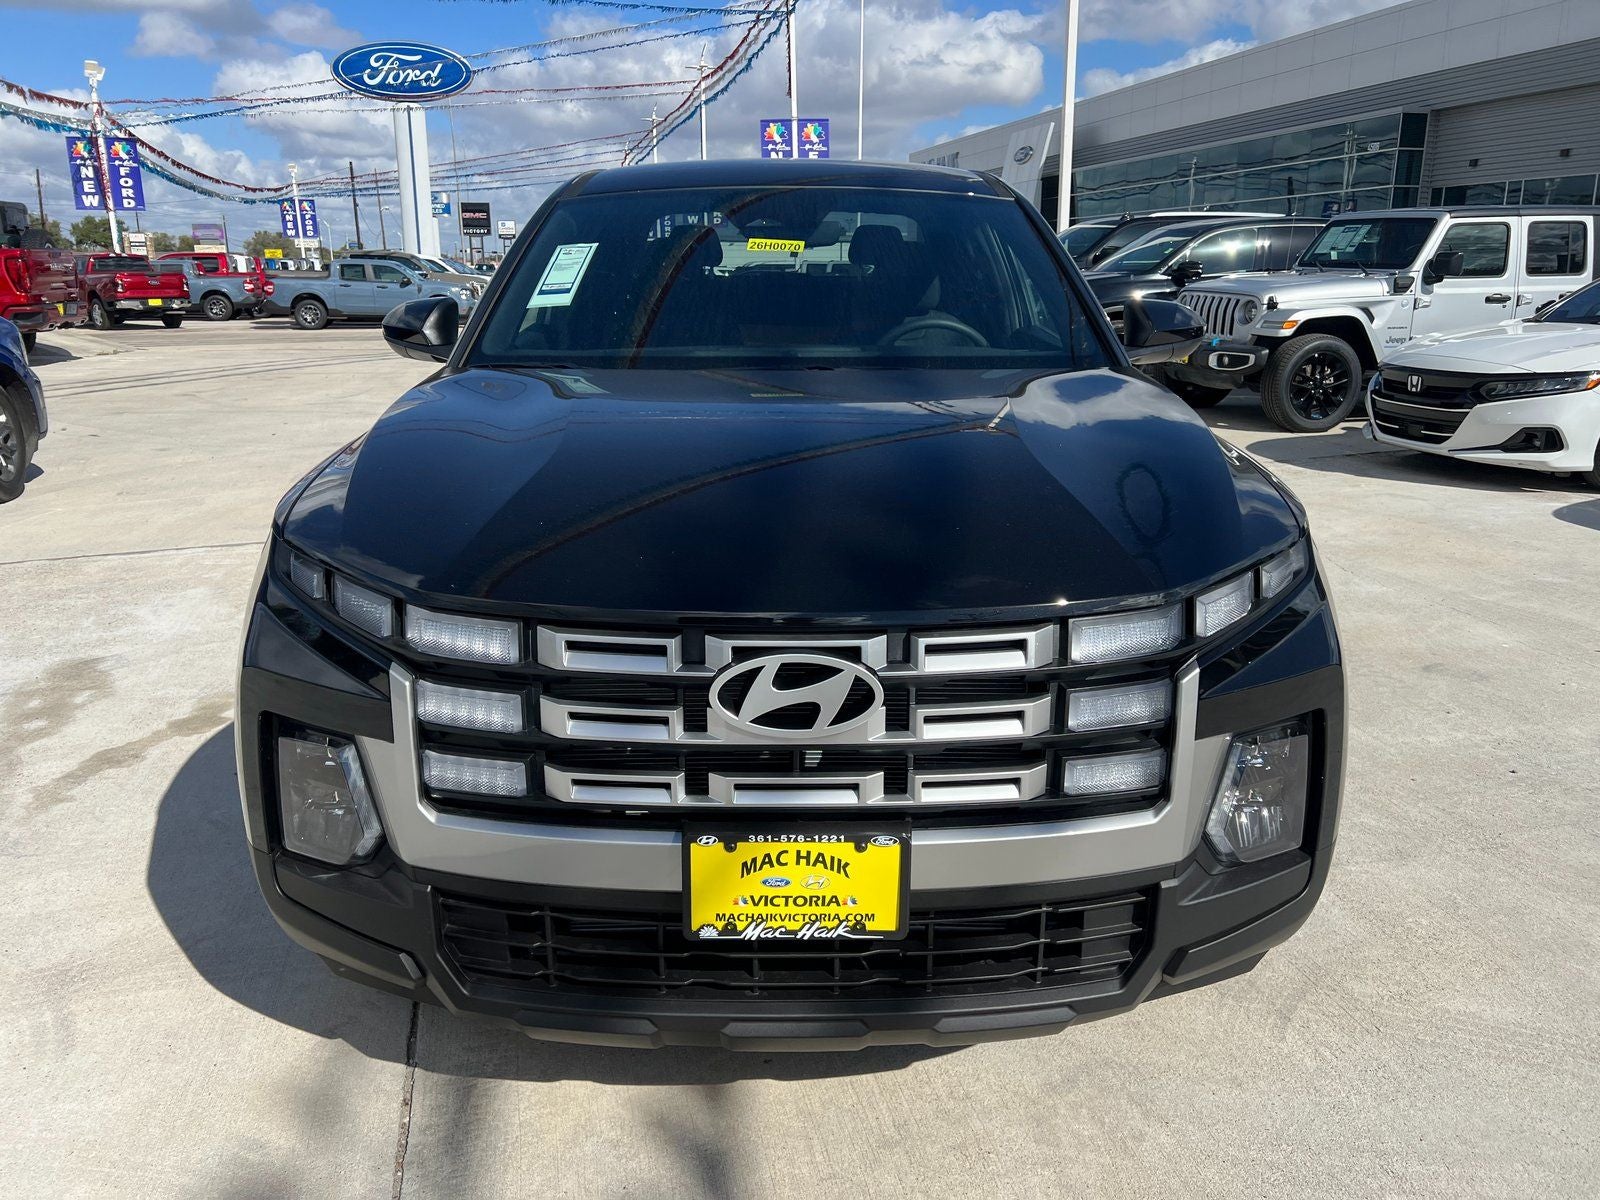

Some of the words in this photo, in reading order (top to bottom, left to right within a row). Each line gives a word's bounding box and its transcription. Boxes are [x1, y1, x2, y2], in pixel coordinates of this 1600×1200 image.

[363, 52, 443, 86] Ford
[80, 166, 99, 207] NEW
[119, 167, 136, 208] FORD
[285, 214, 296, 237] NEW
[749, 241, 801, 251] 26H0070
[748, 834, 845, 843] 361-576-1221
[740, 849, 789, 879] MAC
[795, 849, 851, 879] HAIK
[766, 878, 786, 887] Ford
[749, 895, 842, 907] VICTORIA
[715, 912, 876, 923] MACHAIKVICTORIA.COM
[740, 920, 794, 941] Mac
[796, 920, 853, 941] Haik
